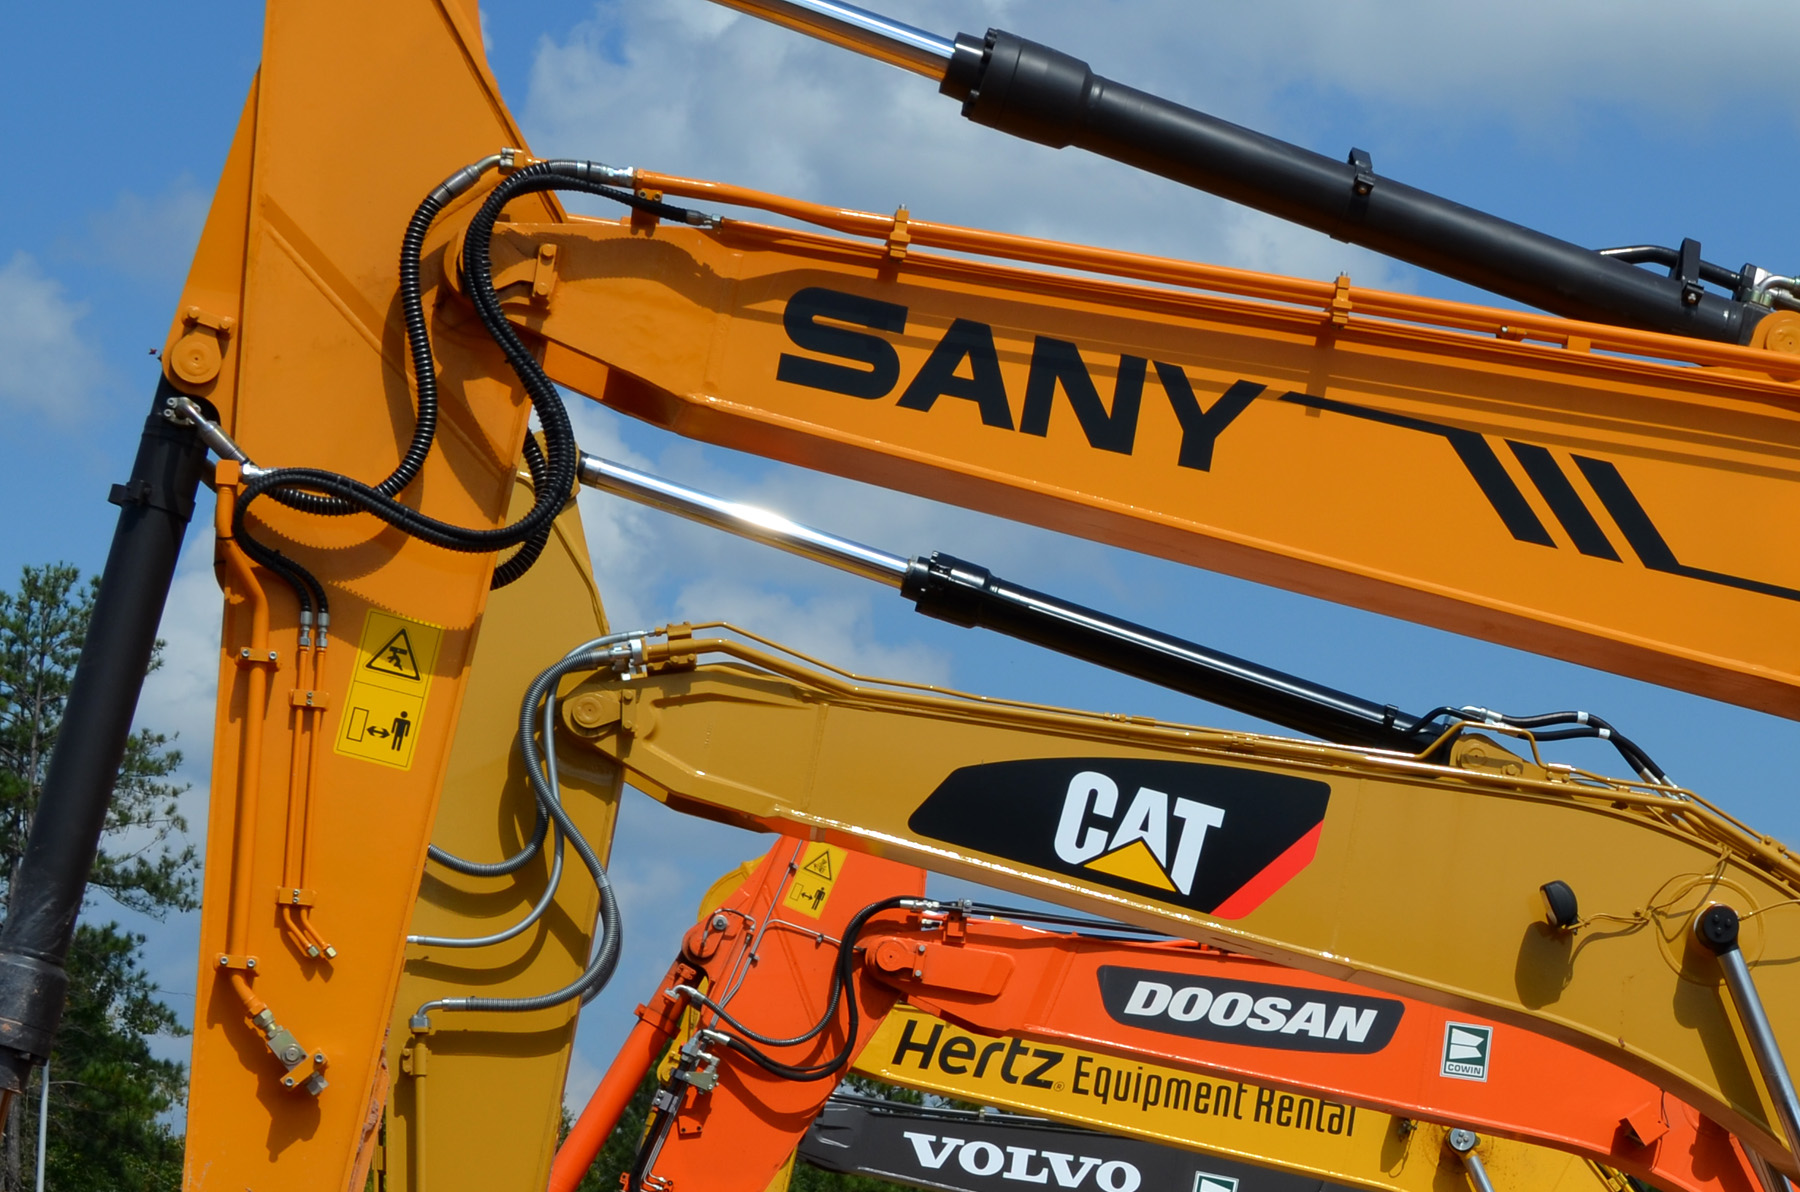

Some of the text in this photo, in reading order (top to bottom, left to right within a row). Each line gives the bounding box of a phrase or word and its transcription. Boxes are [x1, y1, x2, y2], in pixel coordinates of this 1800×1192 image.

[776, 286, 1268, 473] SANY
[1054, 771, 1226, 895] CAT
[1123, 980, 1379, 1043] DOOSAN
[1447, 1063, 1482, 1075] COWIN
[891, 1019, 1357, 1137] Hertz Equipment Rental
